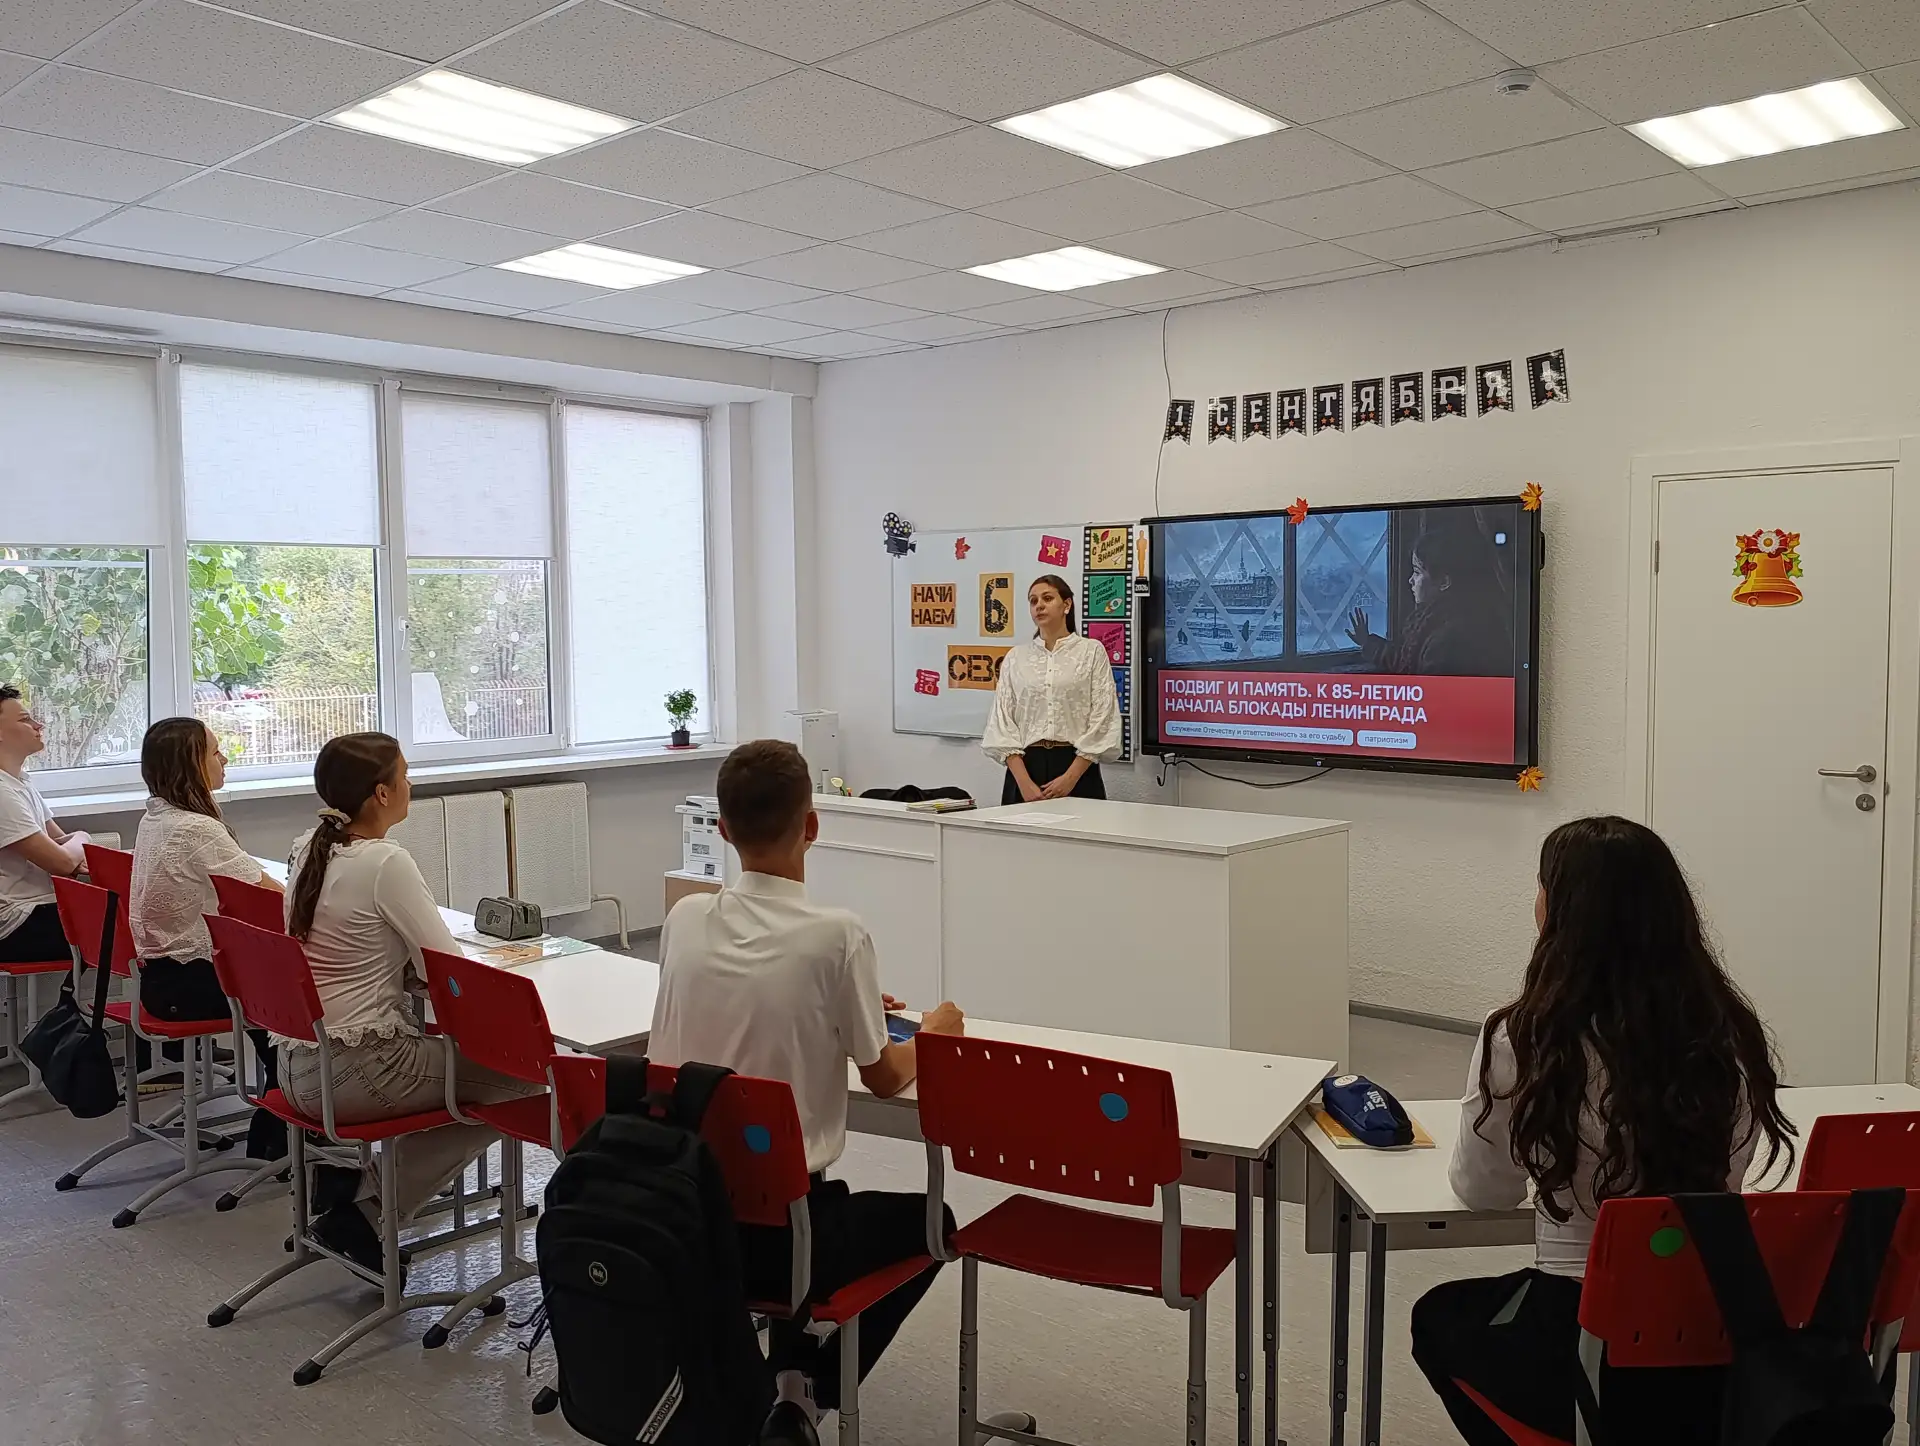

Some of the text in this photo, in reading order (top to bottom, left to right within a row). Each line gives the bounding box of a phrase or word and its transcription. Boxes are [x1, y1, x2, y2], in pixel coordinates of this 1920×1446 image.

[1174, 406, 1185, 427] 1
[913, 586, 953, 603] НАЧИ
[912, 608, 955, 625] НАЕМ
[1165, 679, 1424, 702] ПОДВИГ И ПАМЯТЬ. К 85-ЛЕТИЮ
[1165, 697, 1428, 725] НАЧАЛА БЛОКАДЫ ЛЕНИНГРАДА
[1171, 725, 1202, 734] служение
[1203, 726, 1236, 737] Отечеству
[1242, 730, 1298, 739] ответственность
[1308, 733, 1321, 741] его
[1321, 733, 1347, 742] судьбу
[1364, 735, 1409, 745] патриотизм
[1366, 1090, 1388, 1111] JUST
